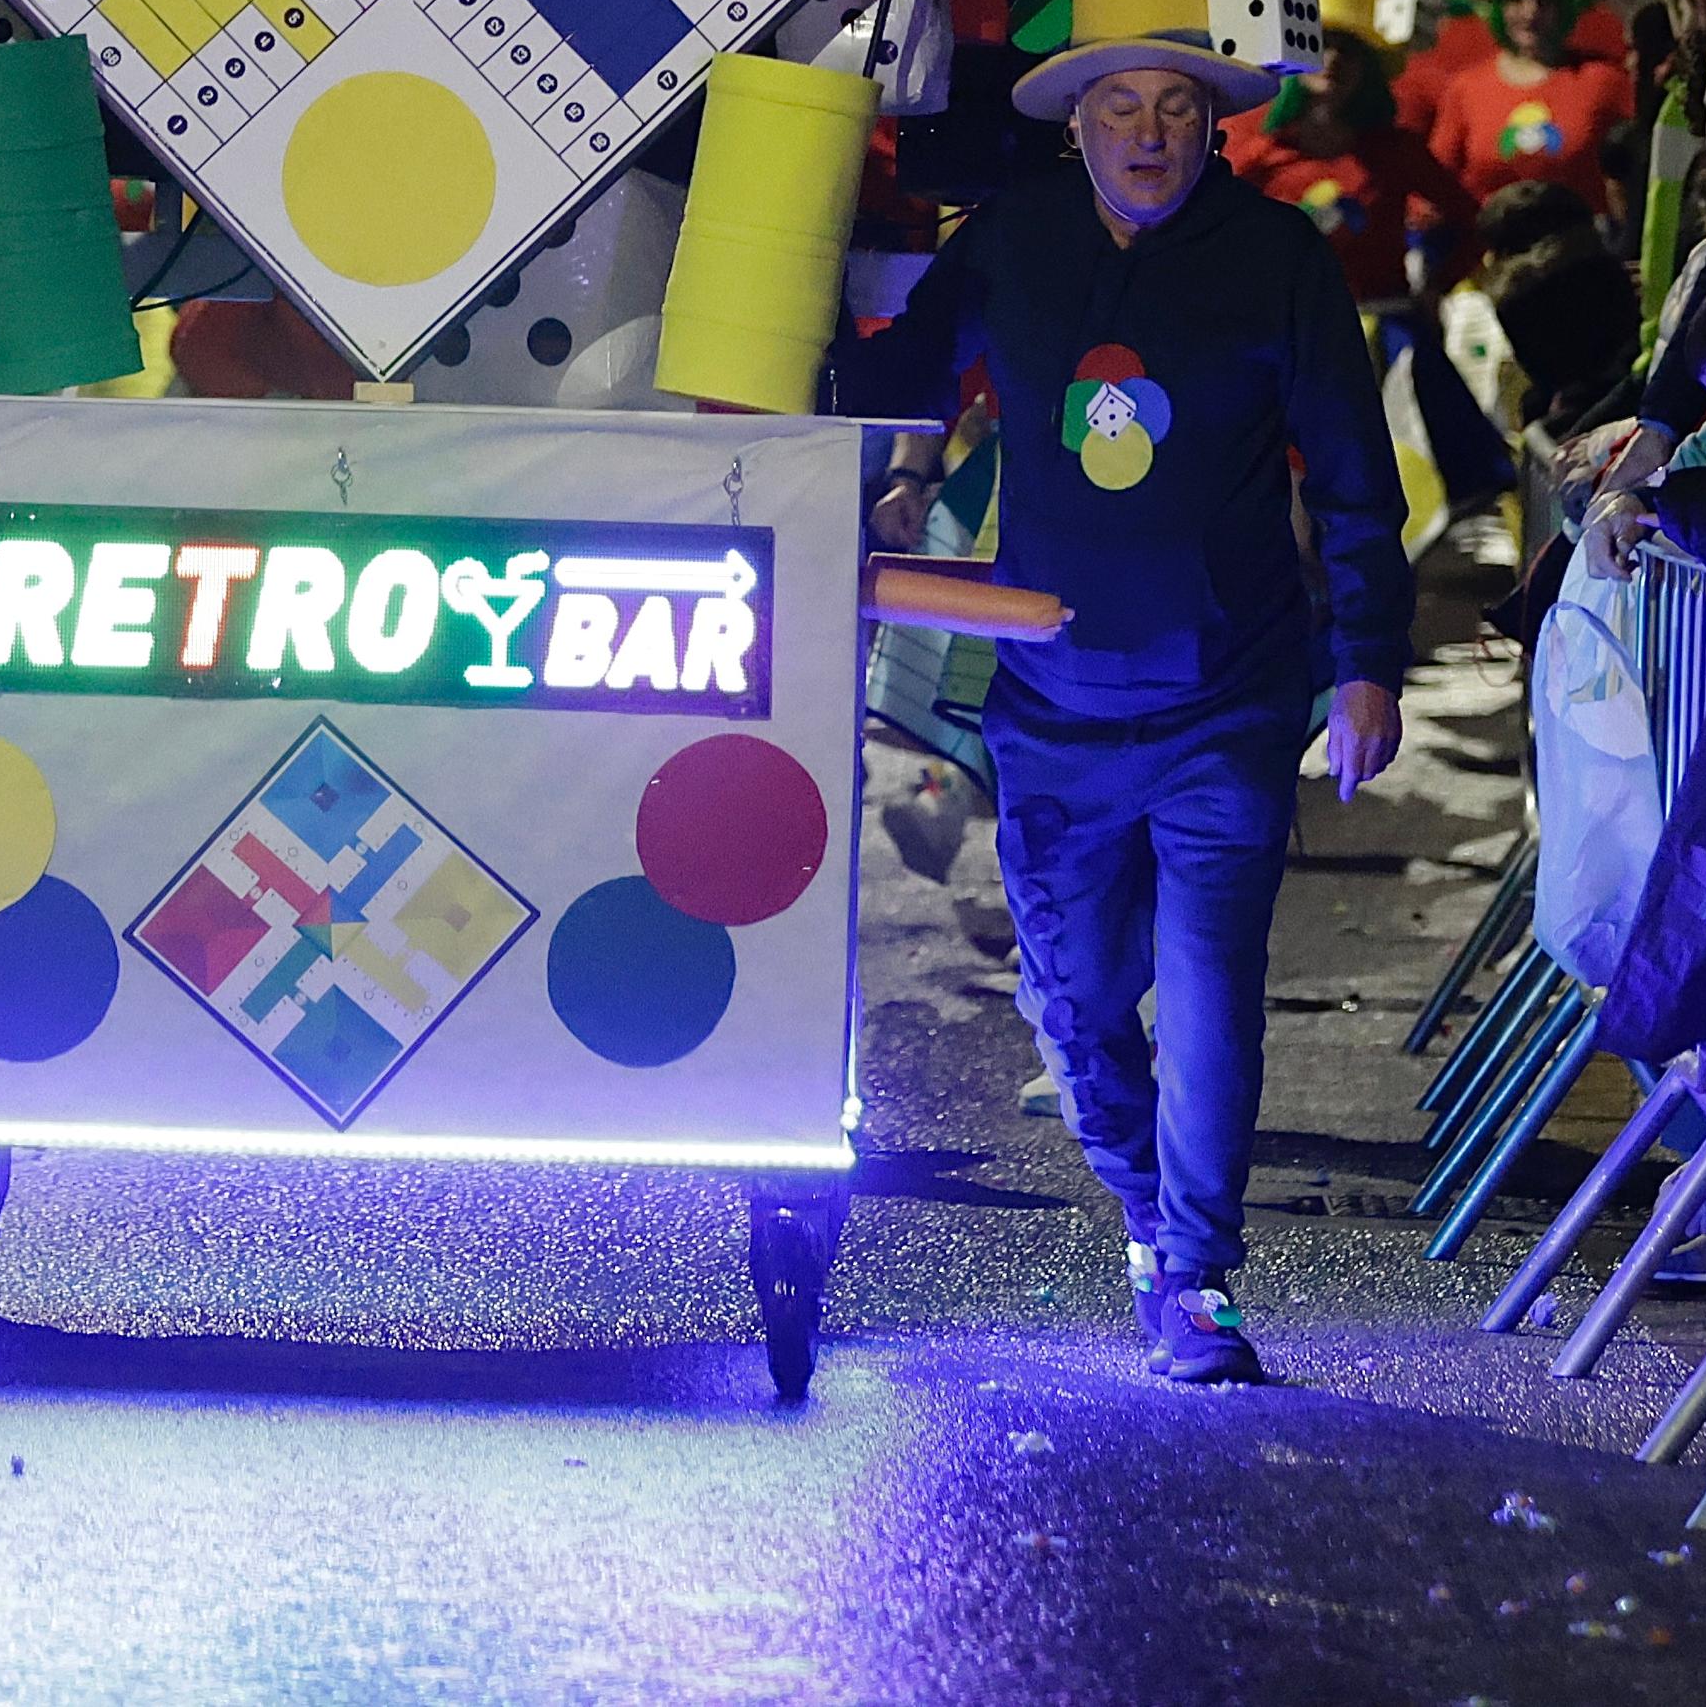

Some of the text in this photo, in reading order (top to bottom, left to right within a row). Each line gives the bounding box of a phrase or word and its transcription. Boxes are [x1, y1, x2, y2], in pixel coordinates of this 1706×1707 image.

[487, 19, 503, 34] 12
[102, 48, 120, 66] 68
[512, 47, 528, 63] 13
[659, 71, 673, 88] 17
[566, 104, 582, 120] 15
[543, 593, 757, 693] BAR
